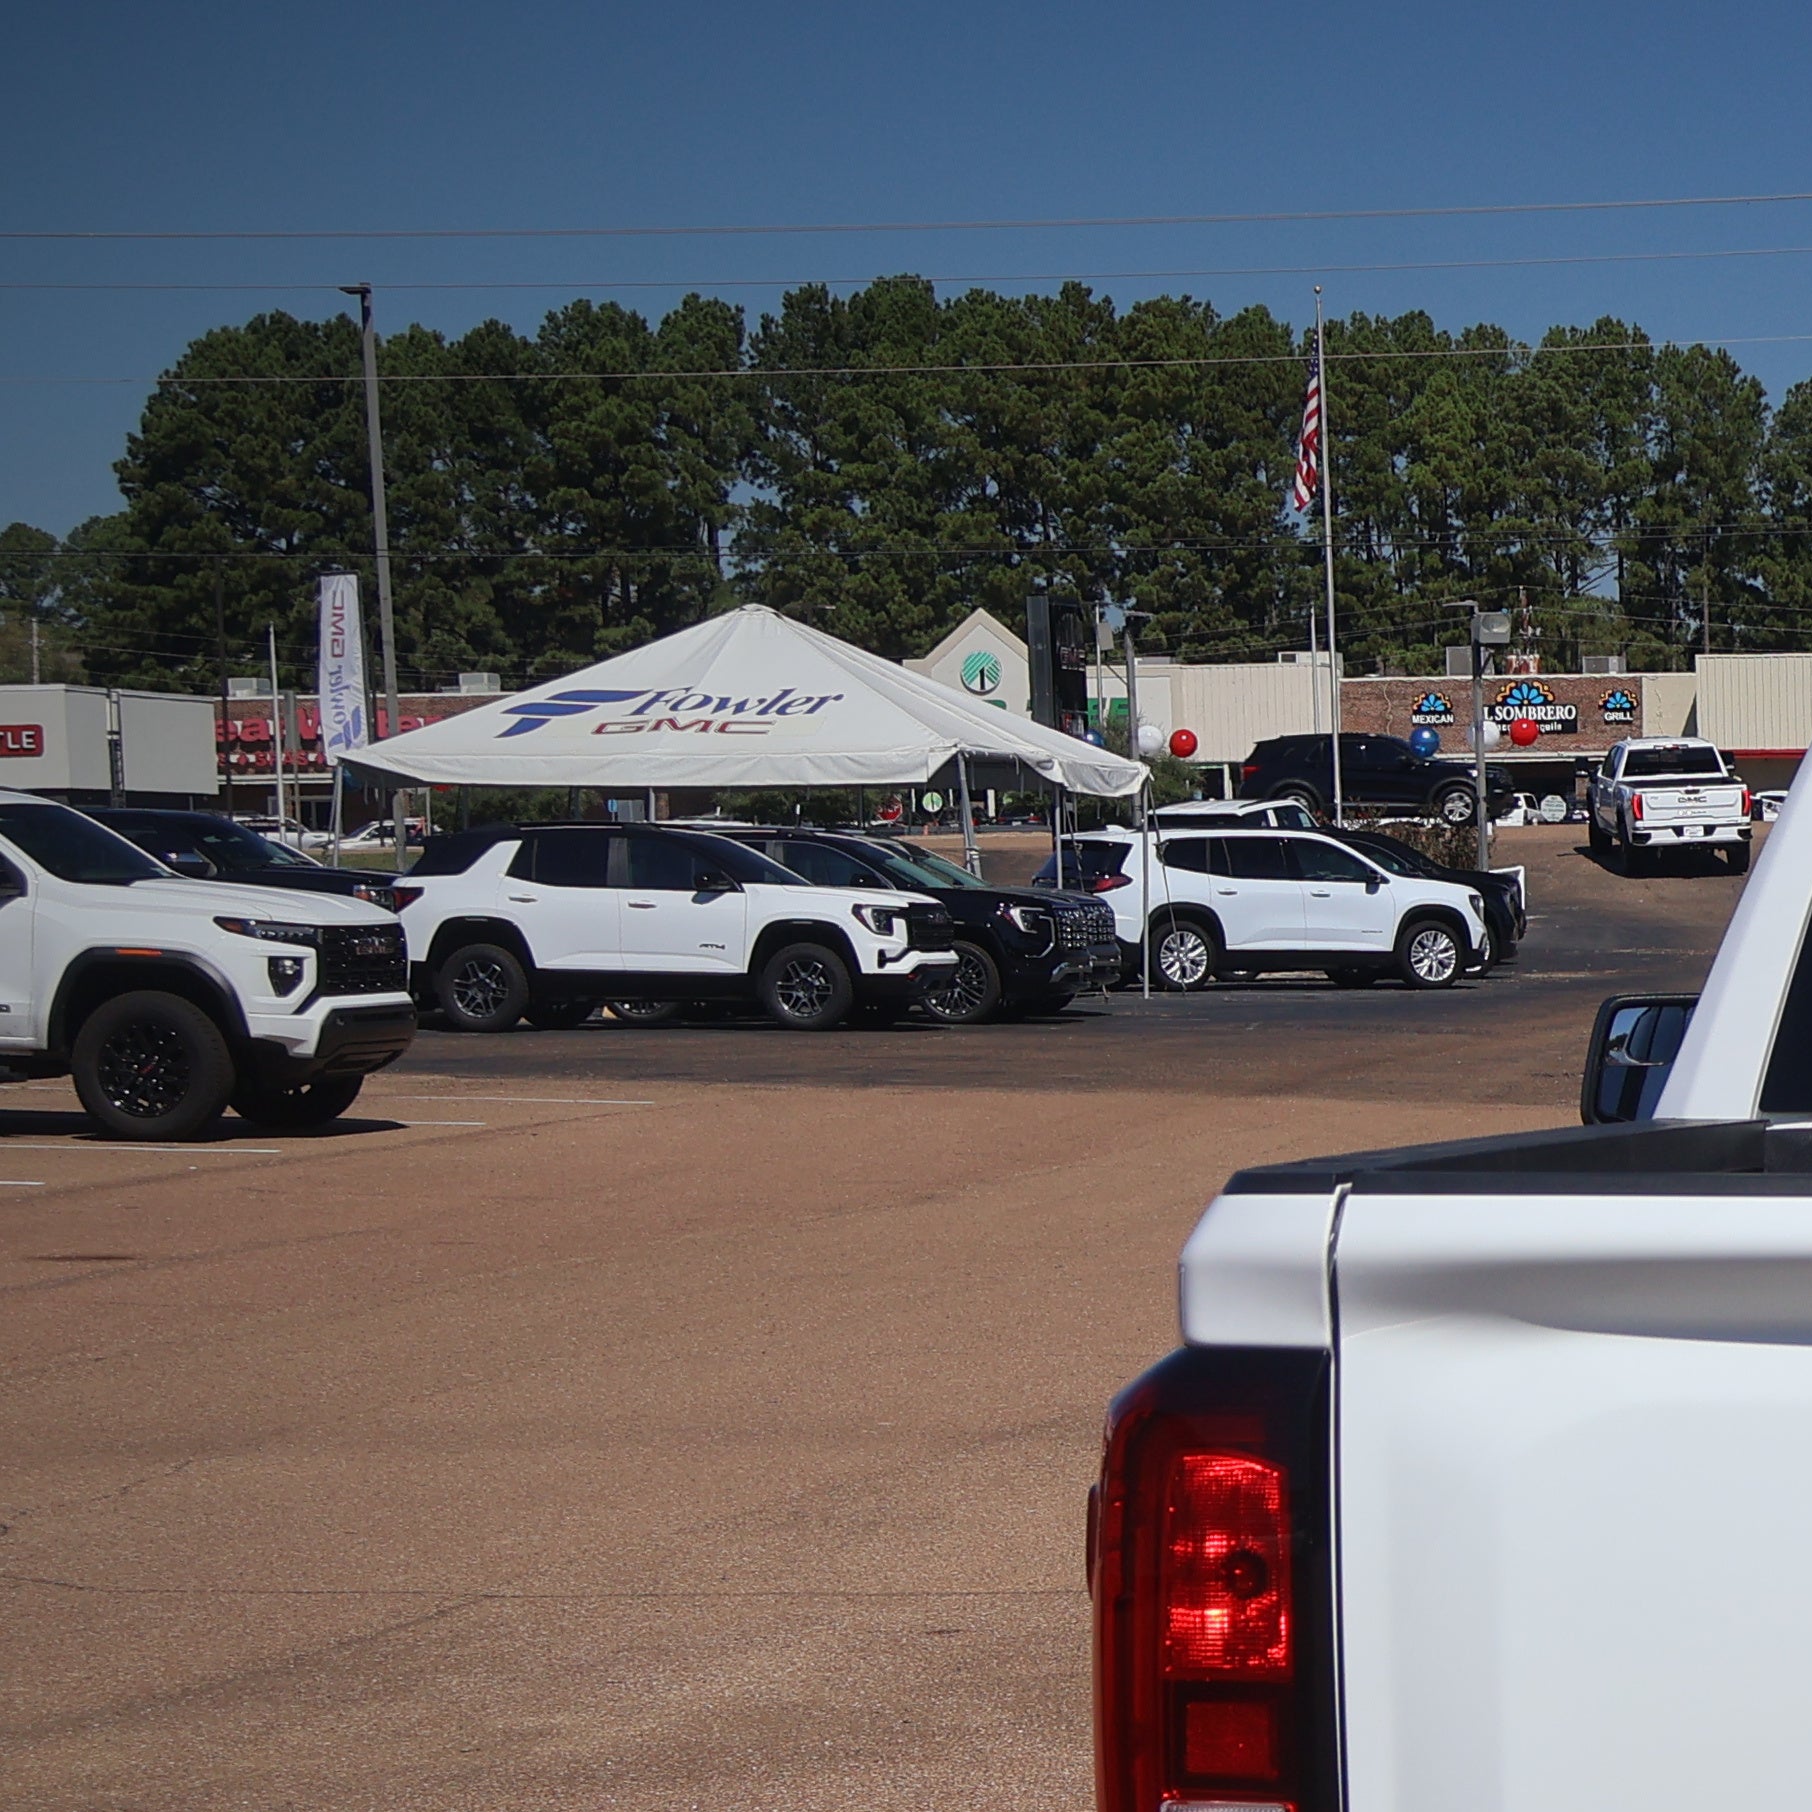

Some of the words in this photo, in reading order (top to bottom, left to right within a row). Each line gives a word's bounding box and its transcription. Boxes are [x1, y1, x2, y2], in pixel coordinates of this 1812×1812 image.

[621, 686, 844, 716] Fowler
[1412, 714, 1454, 724] MEXICAN
[1495, 704, 1577, 721] SOMBRERO
[1604, 711, 1633, 721] GRILL
[590, 716, 777, 735] GMC
[0, 731, 36, 749] LE
